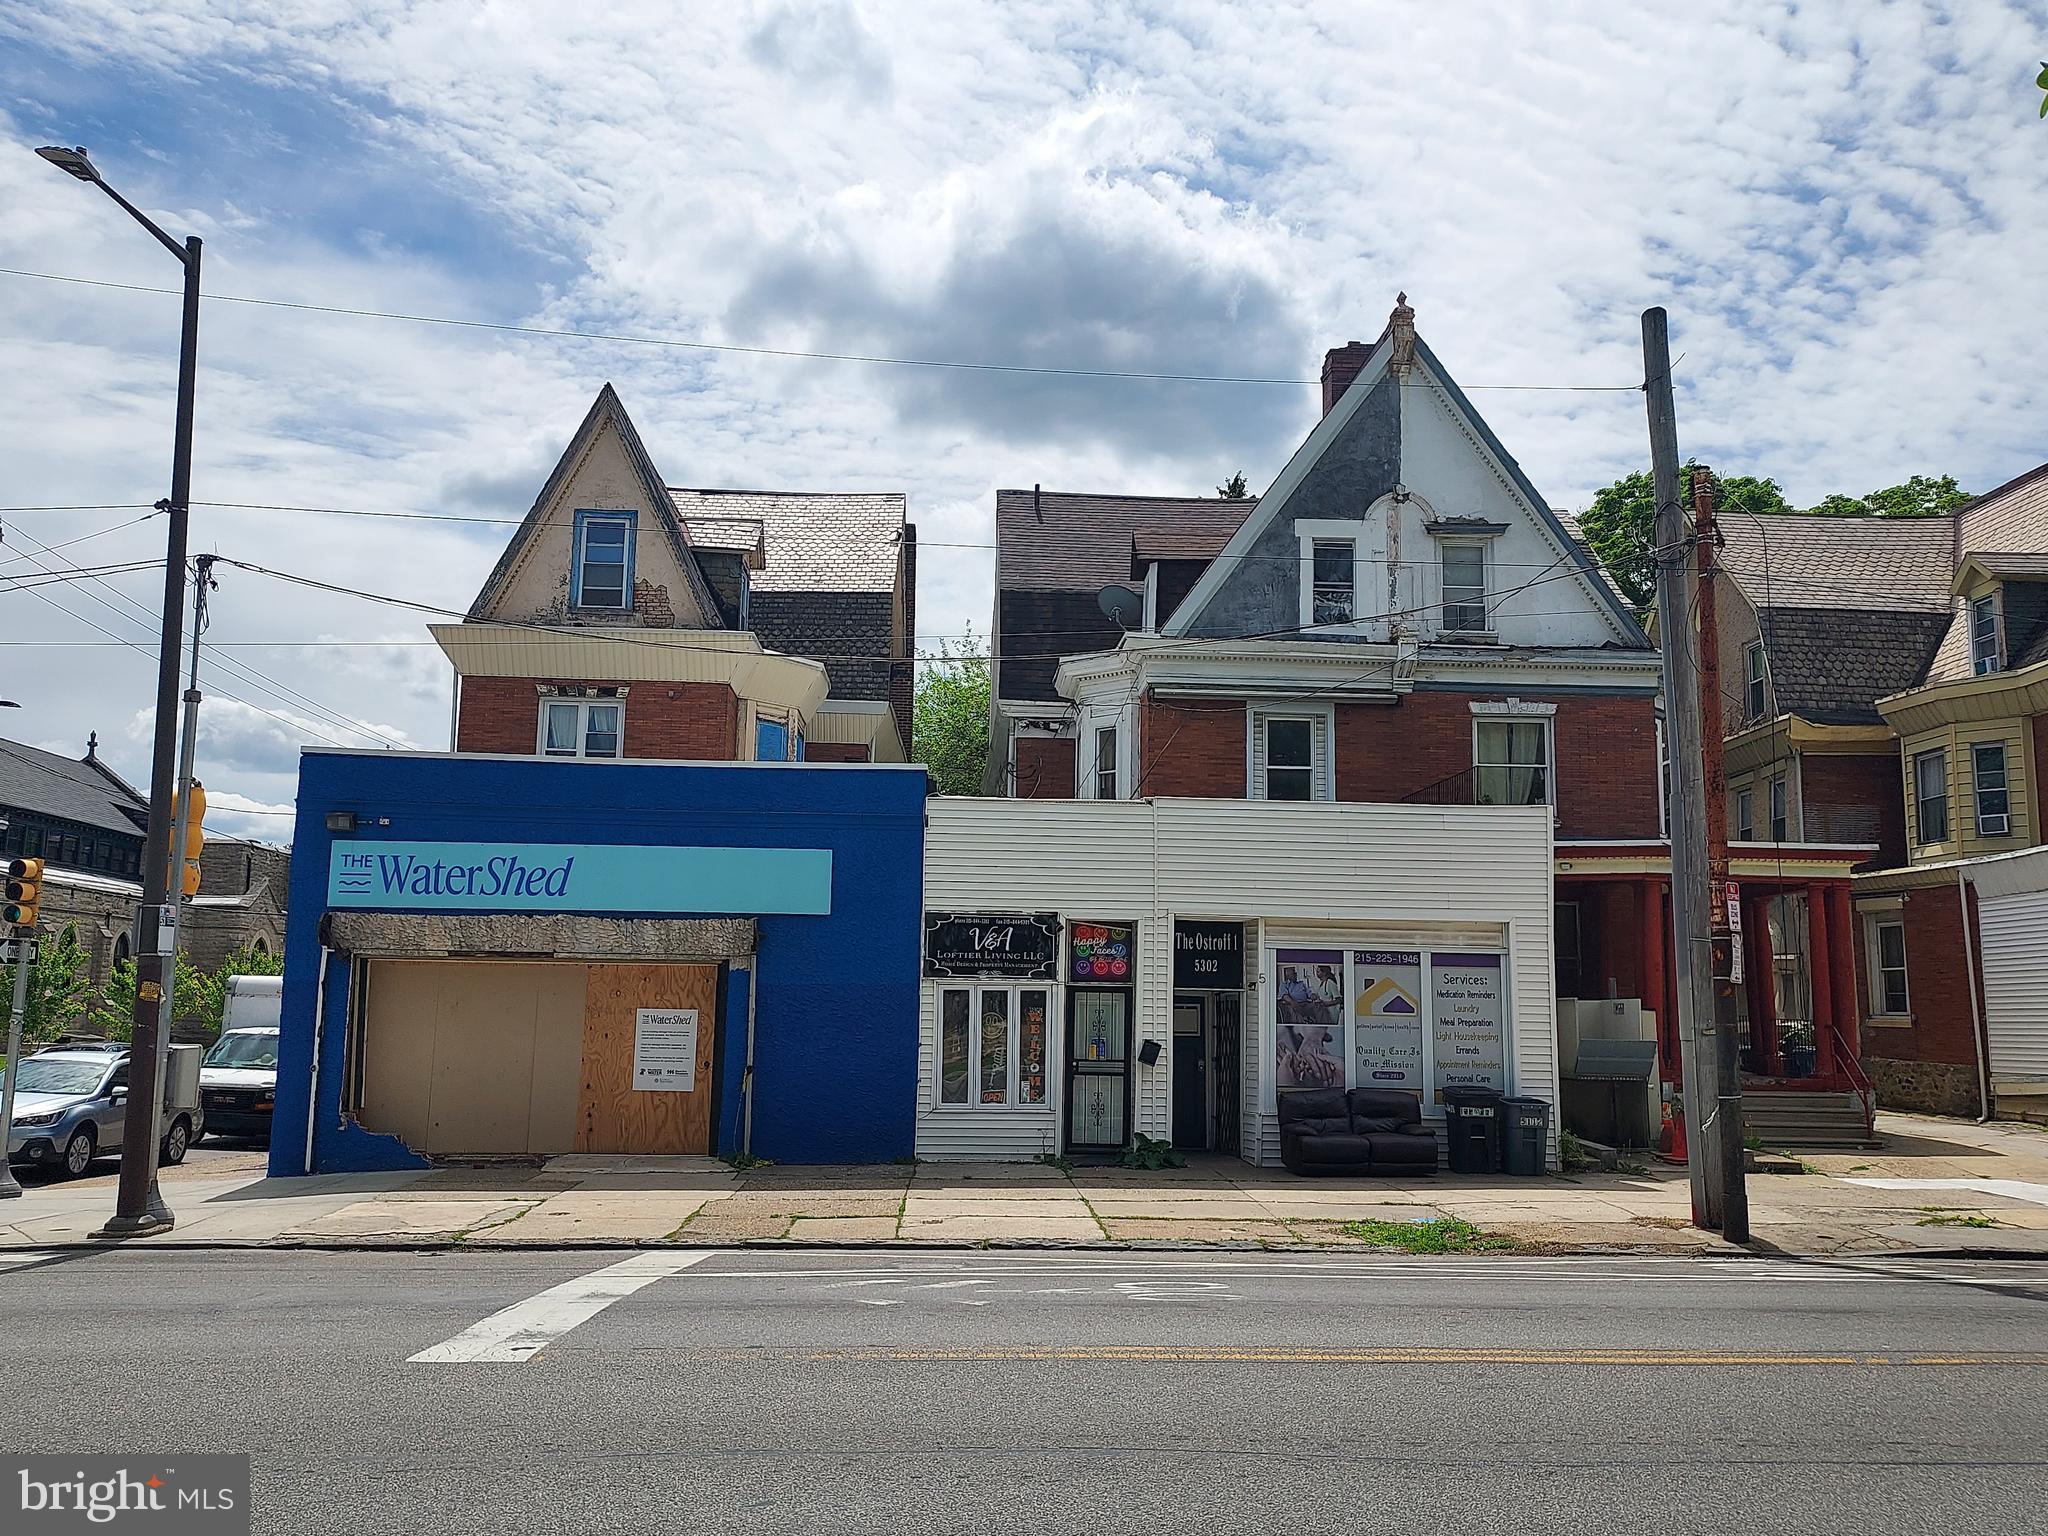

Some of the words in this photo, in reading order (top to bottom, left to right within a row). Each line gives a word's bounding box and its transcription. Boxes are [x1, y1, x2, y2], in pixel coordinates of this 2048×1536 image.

[341, 854, 373, 868] THE
[377, 854, 576, 897] WaterShed
[969, 926, 1014, 951] V&A
[1073, 937, 1107, 947] Happy
[1175, 932, 1194, 950] The
[1195, 932, 1231, 951] Ostroff
[1023, 951, 1045, 960] LLC
[1355, 953, 1419, 964] 215-225-1946
[1194, 959, 1218, 972] 5302
[1258, 972, 1266, 984] 5
[1443, 973, 1488, 985] Services:
[1436, 989, 1465, 999] Medication
[1467, 990, 1496, 999] Reminders
[1454, 1004, 1480, 1014] Laundry
[650, 1014, 692, 1025] WaterShed
[1440, 1017, 1455, 1026] Meal
[1457, 1017, 1494, 1028] Preparation
[1436, 1031, 1452, 1041] Light
[1454, 1031, 1499, 1042] Housekeeping
[1356, 1045, 1386, 1057] Quality
[1388, 1046, 1408, 1056] Care
[1455, 1046, 1480, 1055] Errands
[1362, 1058, 1379, 1068] Our
[1380, 1059, 1415, 1070] Mission
[1436, 1059, 1470, 1070] Appointment
[1471, 1060, 1501, 1069] Reminders
[1446, 1073, 1473, 1083] Personal
[1475, 1074, 1491, 1083] Care
